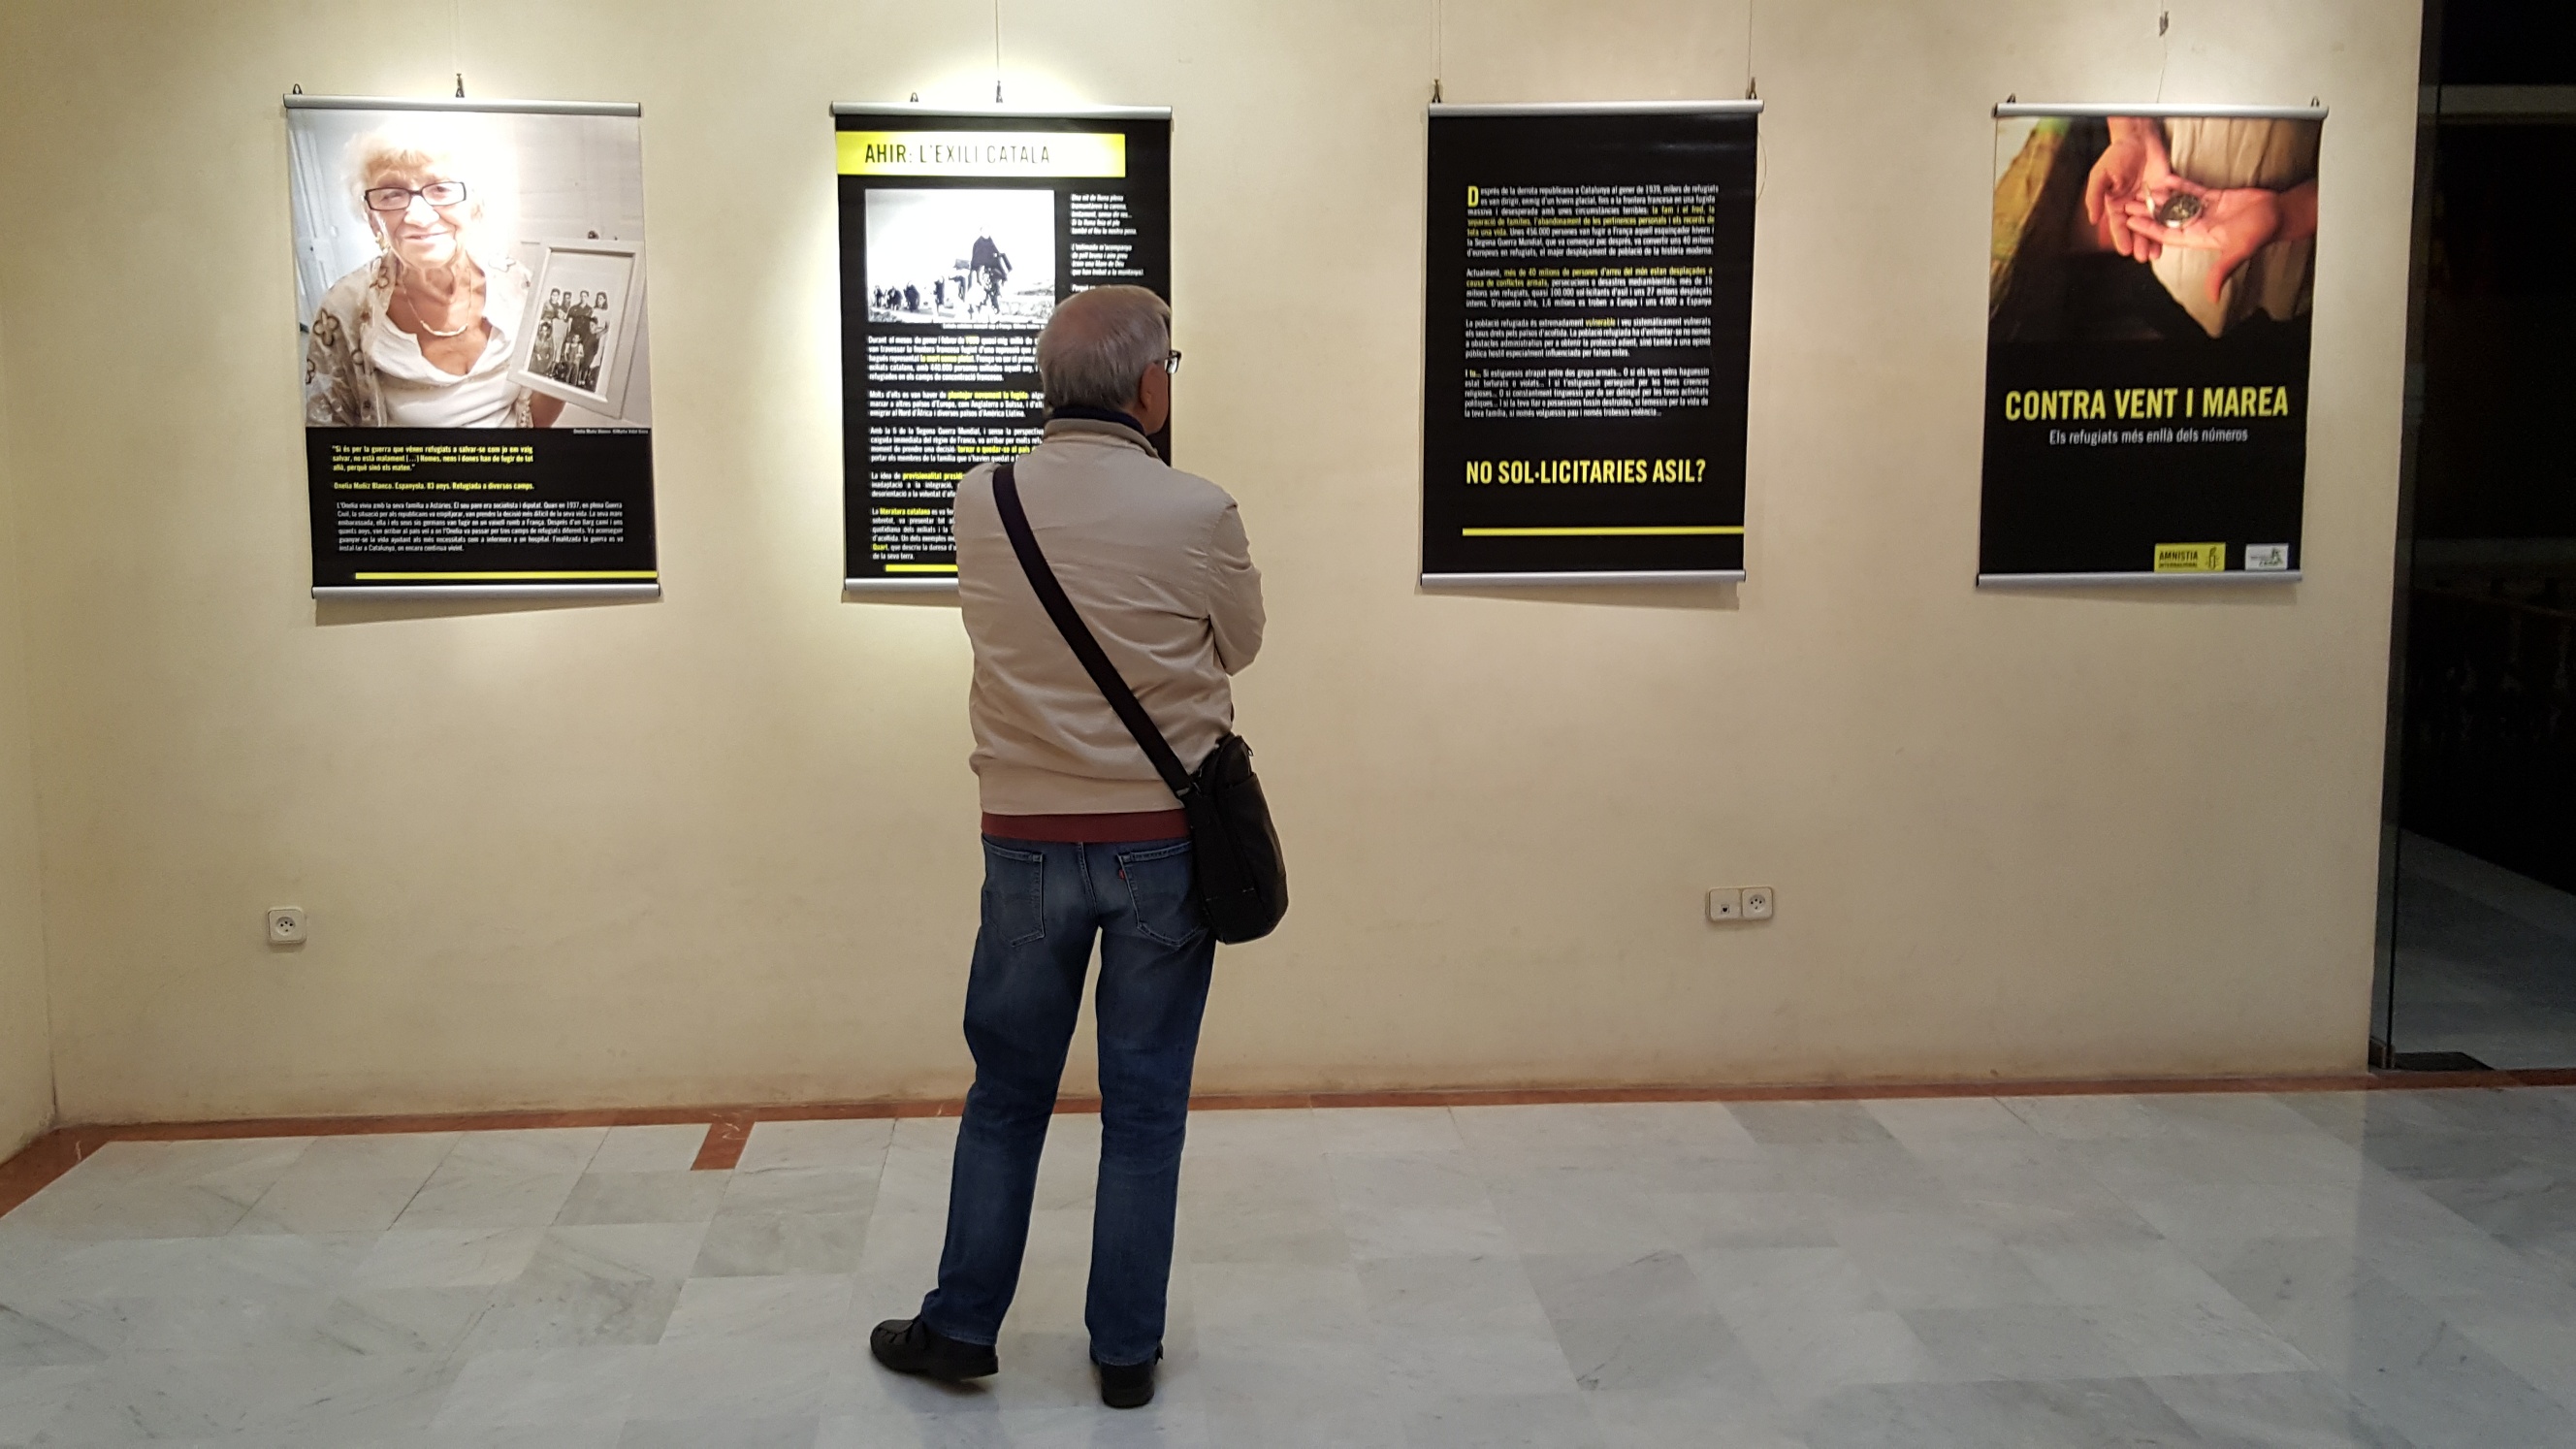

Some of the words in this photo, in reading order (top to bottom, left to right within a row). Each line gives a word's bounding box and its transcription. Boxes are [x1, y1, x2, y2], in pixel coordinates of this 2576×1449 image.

[865, 144, 913, 163] AHIR:
[920, 145, 978, 163] L'EXILI
[2005, 390, 2106, 421] CONTRA
[2114, 388, 2178, 419] VENT
[2186, 388, 2194, 418] I
[2203, 386, 2289, 418] MAREA
[2049, 429, 2066, 445] Els
[2069, 429, 2118, 447] refugiats
[2121, 428, 2144, 444] més
[2146, 428, 2173, 444] enllà
[2176, 427, 2198, 443] dels
[2202, 428, 2248, 443] números
[1466, 461, 1492, 484] NO
[1498, 460, 1647, 484] SOL·LICITARIES
[1652, 459, 1706, 483] ASIL?
[2159, 551, 2198, 561] AMNISTIA
